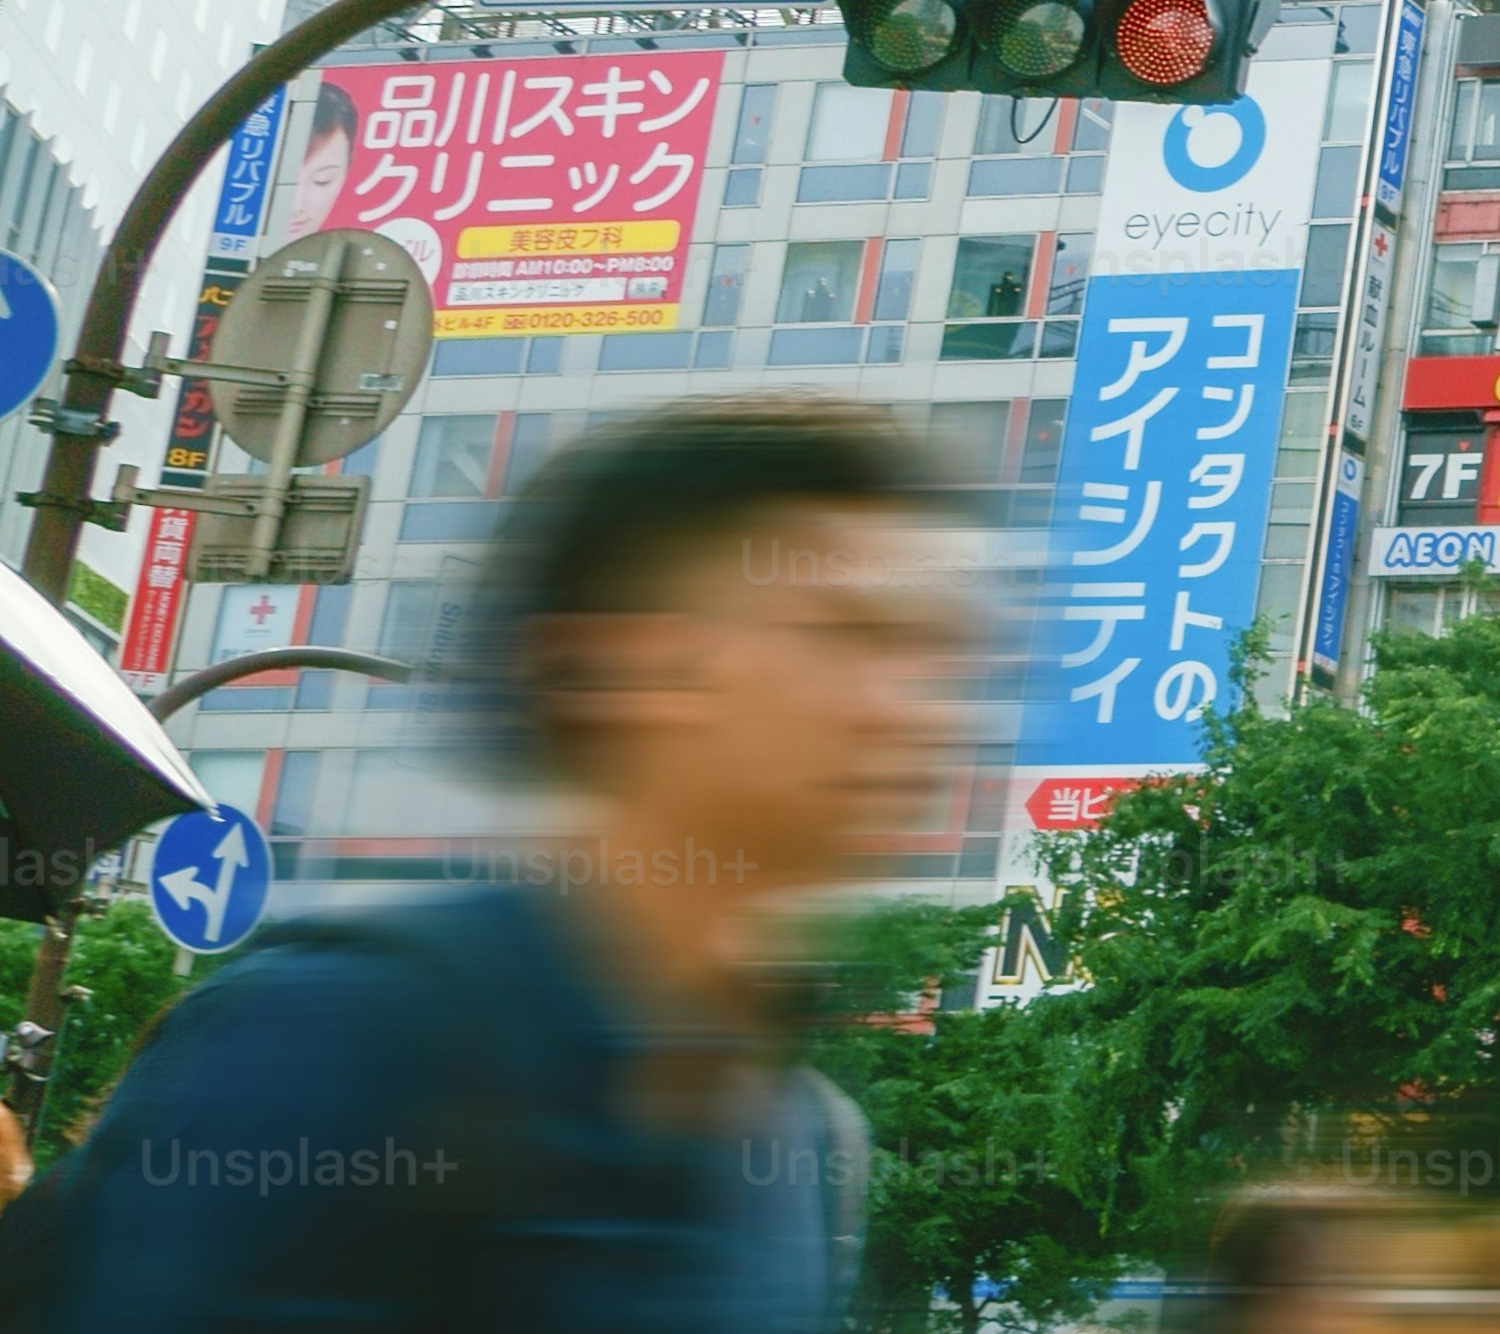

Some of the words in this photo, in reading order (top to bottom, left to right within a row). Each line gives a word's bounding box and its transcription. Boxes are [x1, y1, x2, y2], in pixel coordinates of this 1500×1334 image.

[363, 66, 711, 151] 品川スキン
[356, 143, 696, 223] クリニック
[508, 226, 624, 255] 美容皮フ科
[1125, 201, 1283, 251] eyecity
[528, 309, 664, 330] 0120-326-500
[168, 446, 207, 467] 8F
[1409, 453, 1484, 501] 7F
[1060, 316, 1191, 725] アイシティ
[1153, 313, 1267, 723] コンタクトの
[1384, 531, 1496, 569] AEON
